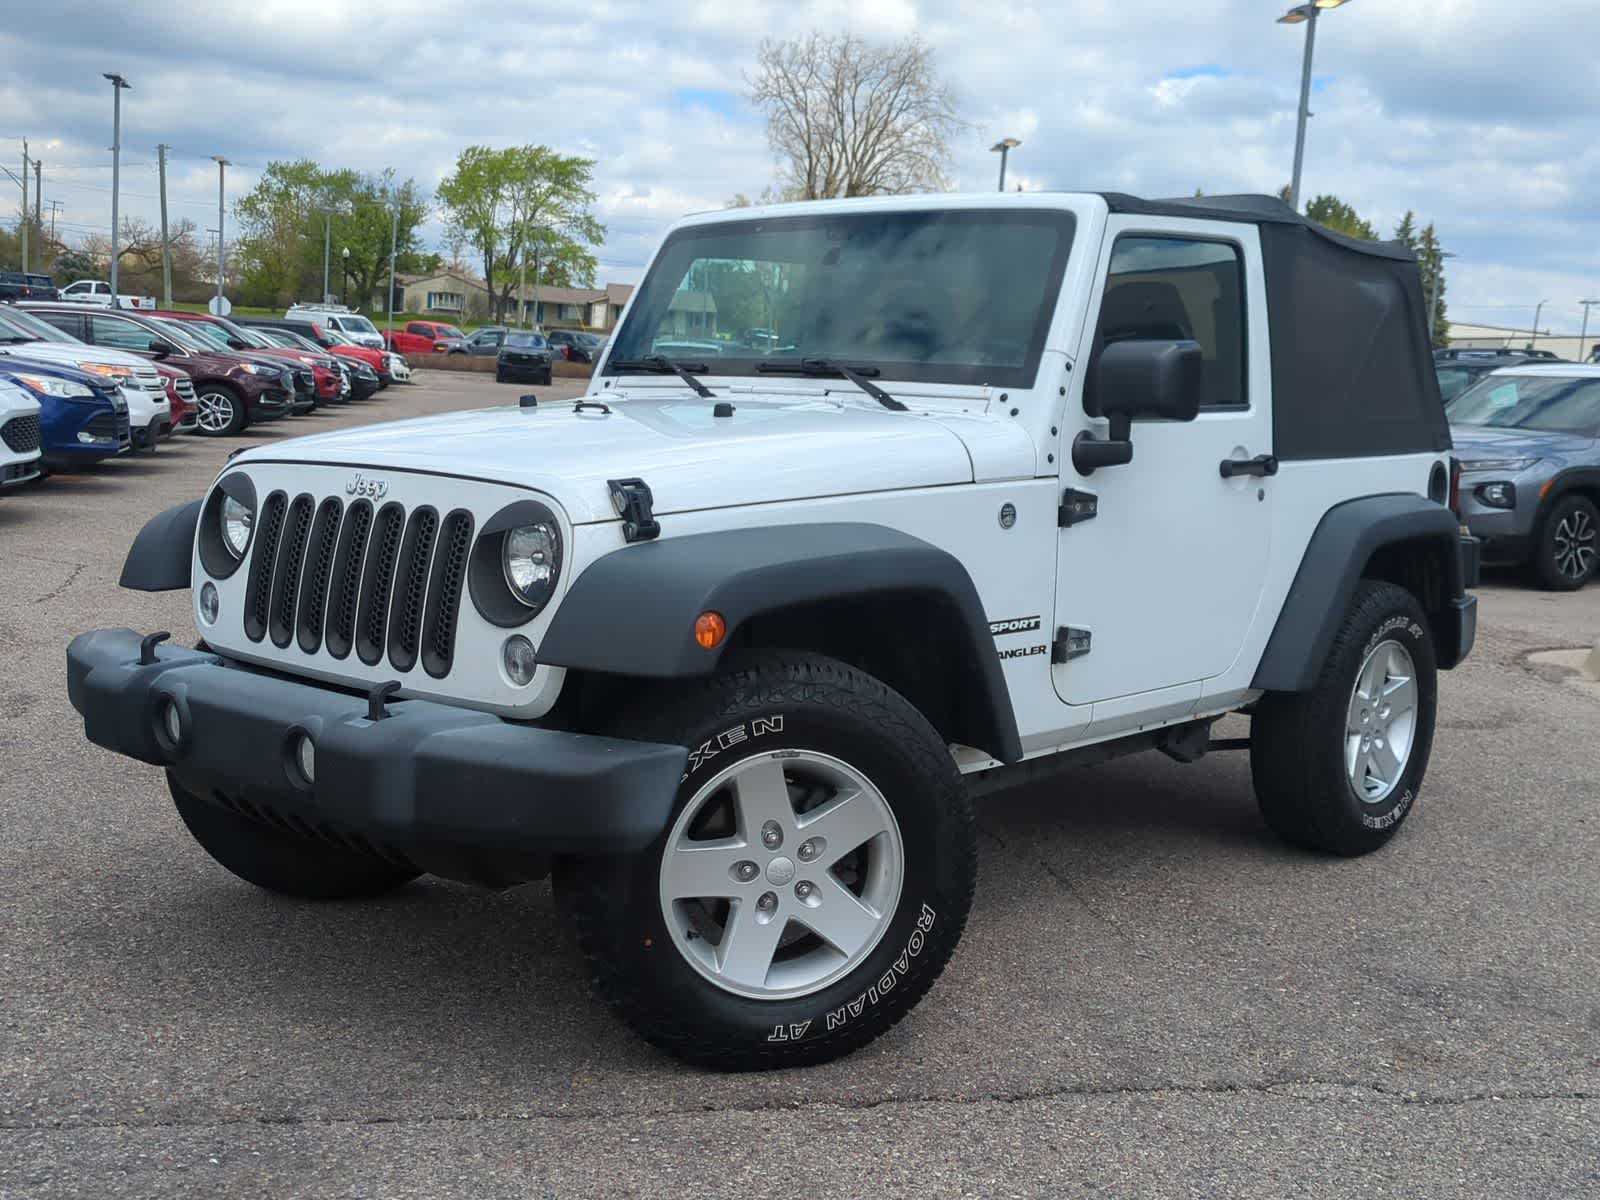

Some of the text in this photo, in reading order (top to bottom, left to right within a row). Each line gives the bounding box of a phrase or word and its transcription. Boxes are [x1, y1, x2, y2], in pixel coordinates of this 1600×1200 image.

[346, 472, 389, 502] Jeep
[989, 618, 1040, 633] SPORT
[999, 644, 1046, 660] ANGLER
[681, 715, 783, 784] XEN
[767, 904, 936, 1041] ROADIAN AT
